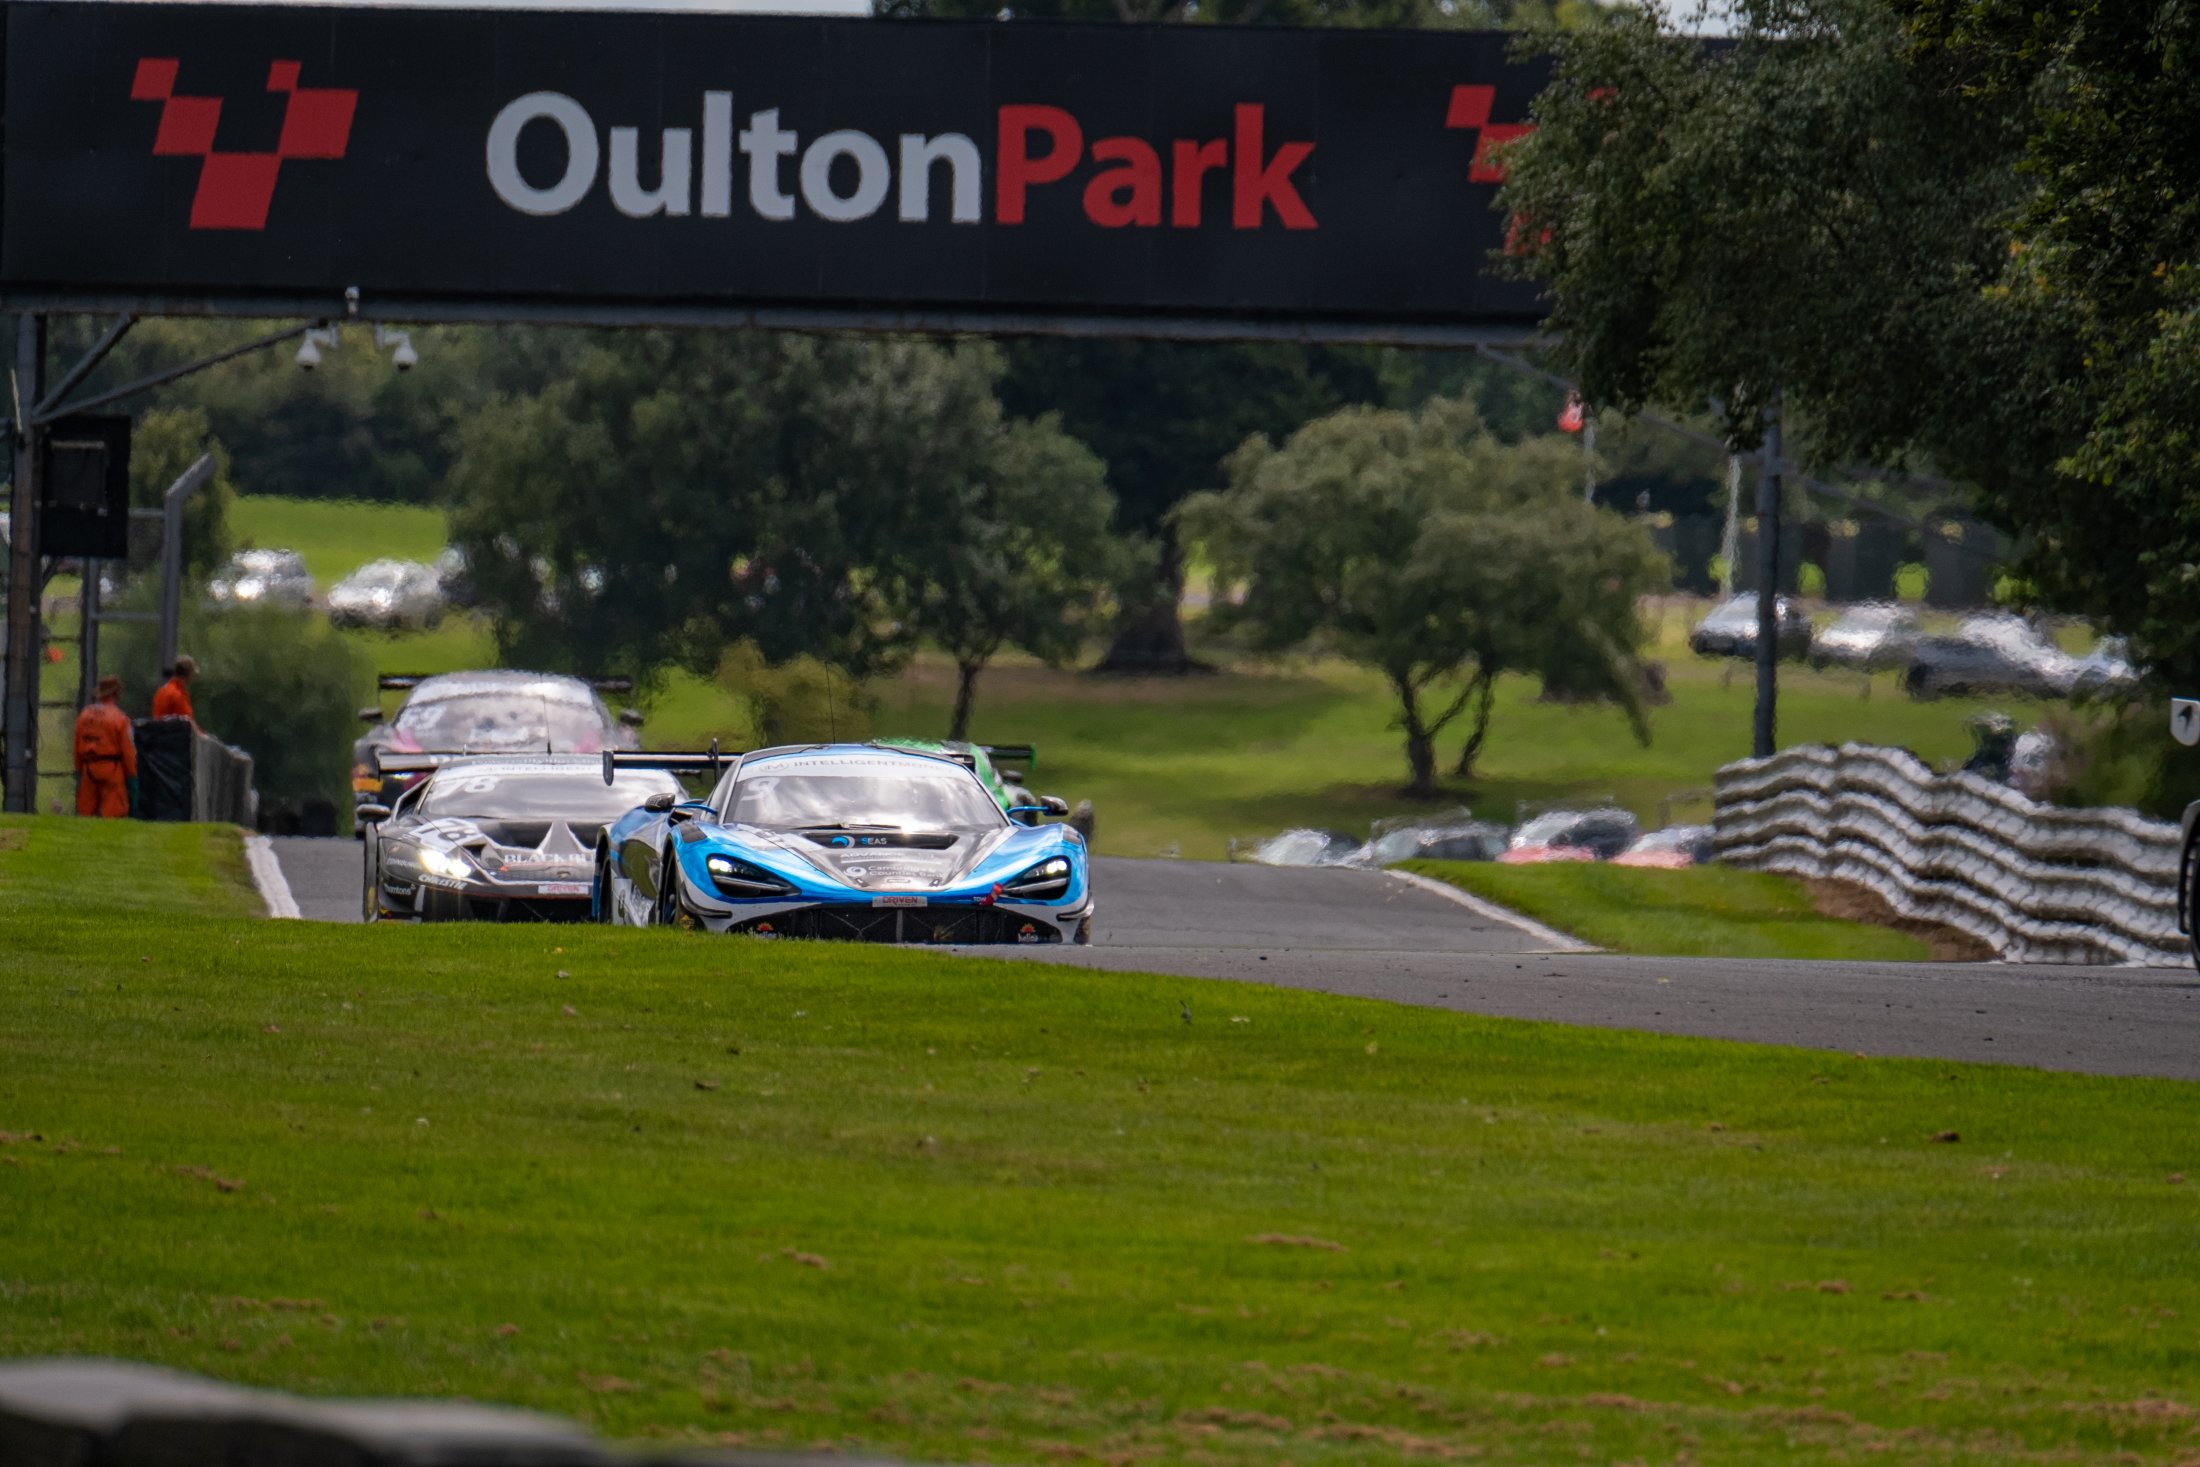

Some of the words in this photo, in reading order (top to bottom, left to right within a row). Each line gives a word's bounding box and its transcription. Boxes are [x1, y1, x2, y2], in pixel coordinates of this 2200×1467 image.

[861, 837, 887, 846] SEAS
[569, 853, 597, 864] BU
[882, 896, 918, 905] DRIVEN
